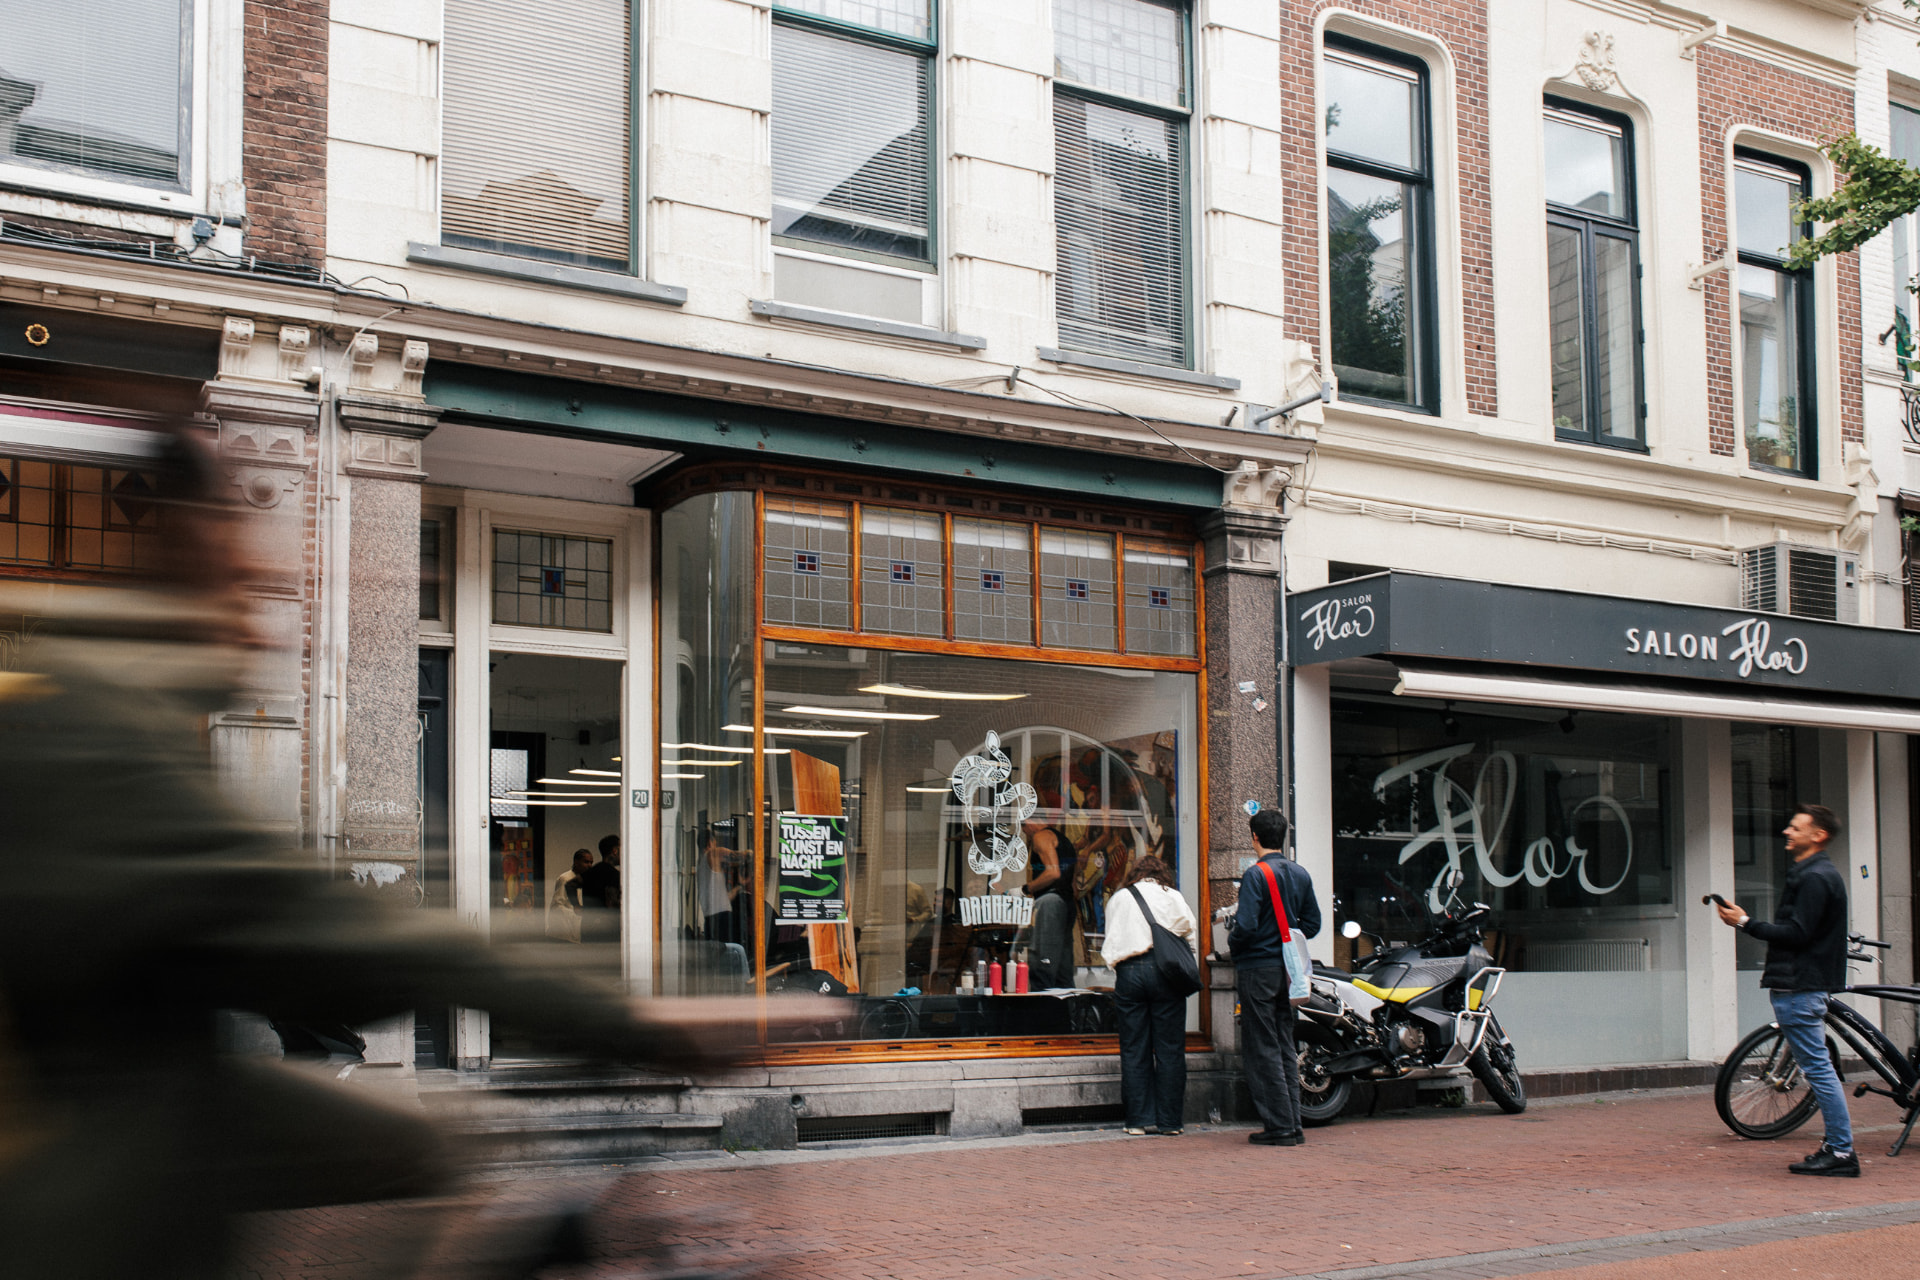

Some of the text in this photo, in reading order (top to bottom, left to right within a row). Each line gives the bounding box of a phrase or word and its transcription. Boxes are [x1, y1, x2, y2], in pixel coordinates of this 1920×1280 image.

[1341, 594, 1373, 608] SALON
[1300, 599, 1375, 651] Flor
[1625, 618, 1808, 678] SALON Flor
[634, 791, 647, 804] 20
[781, 825, 831, 840] TUSSEN
[1373, 742, 1633, 914] Flor
[781, 840, 843, 855] KUNST EN
[781, 854, 824, 869] NACHT
[959, 895, 1034, 927] DAGGERS
